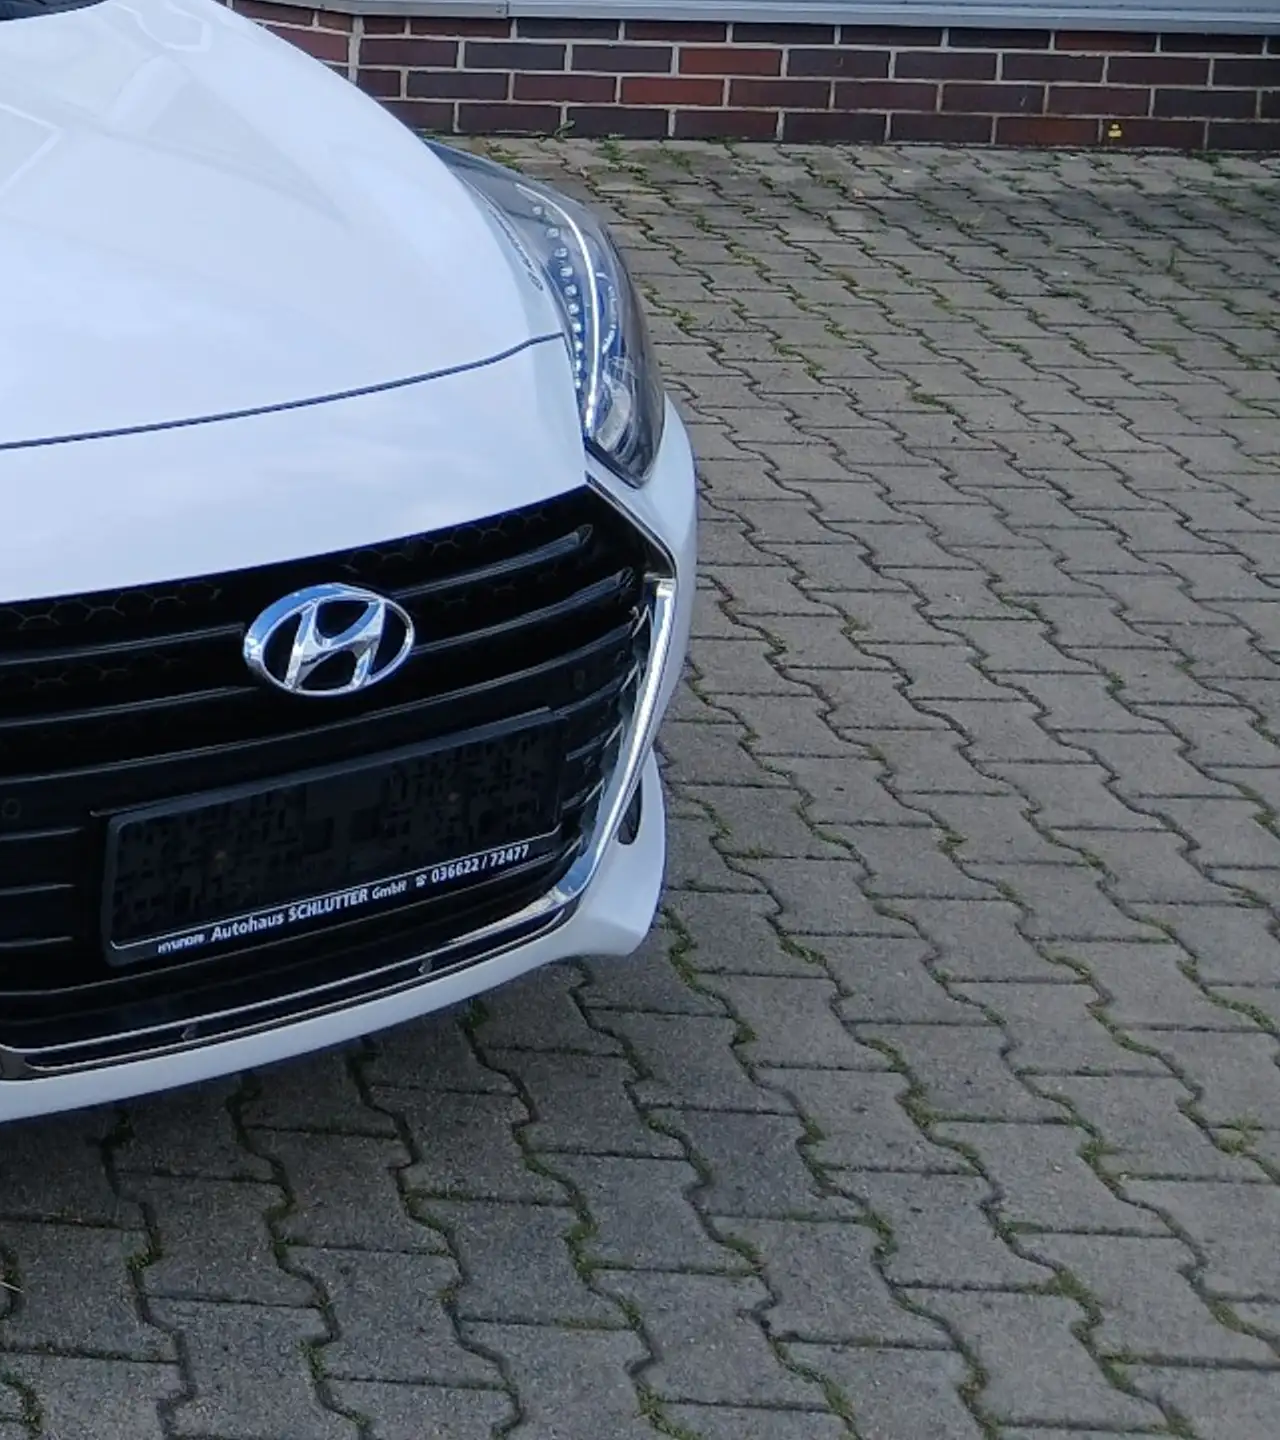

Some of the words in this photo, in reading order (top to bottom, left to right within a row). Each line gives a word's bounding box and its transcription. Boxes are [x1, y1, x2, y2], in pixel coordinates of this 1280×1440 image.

[210, 912, 285, 943] Autohaus
[287, 888, 369, 923] SCHLUTTER
[371, 881, 407, 901] GmbH
[430, 857, 480, 884] 036622
[489, 844, 530, 868] 72477
